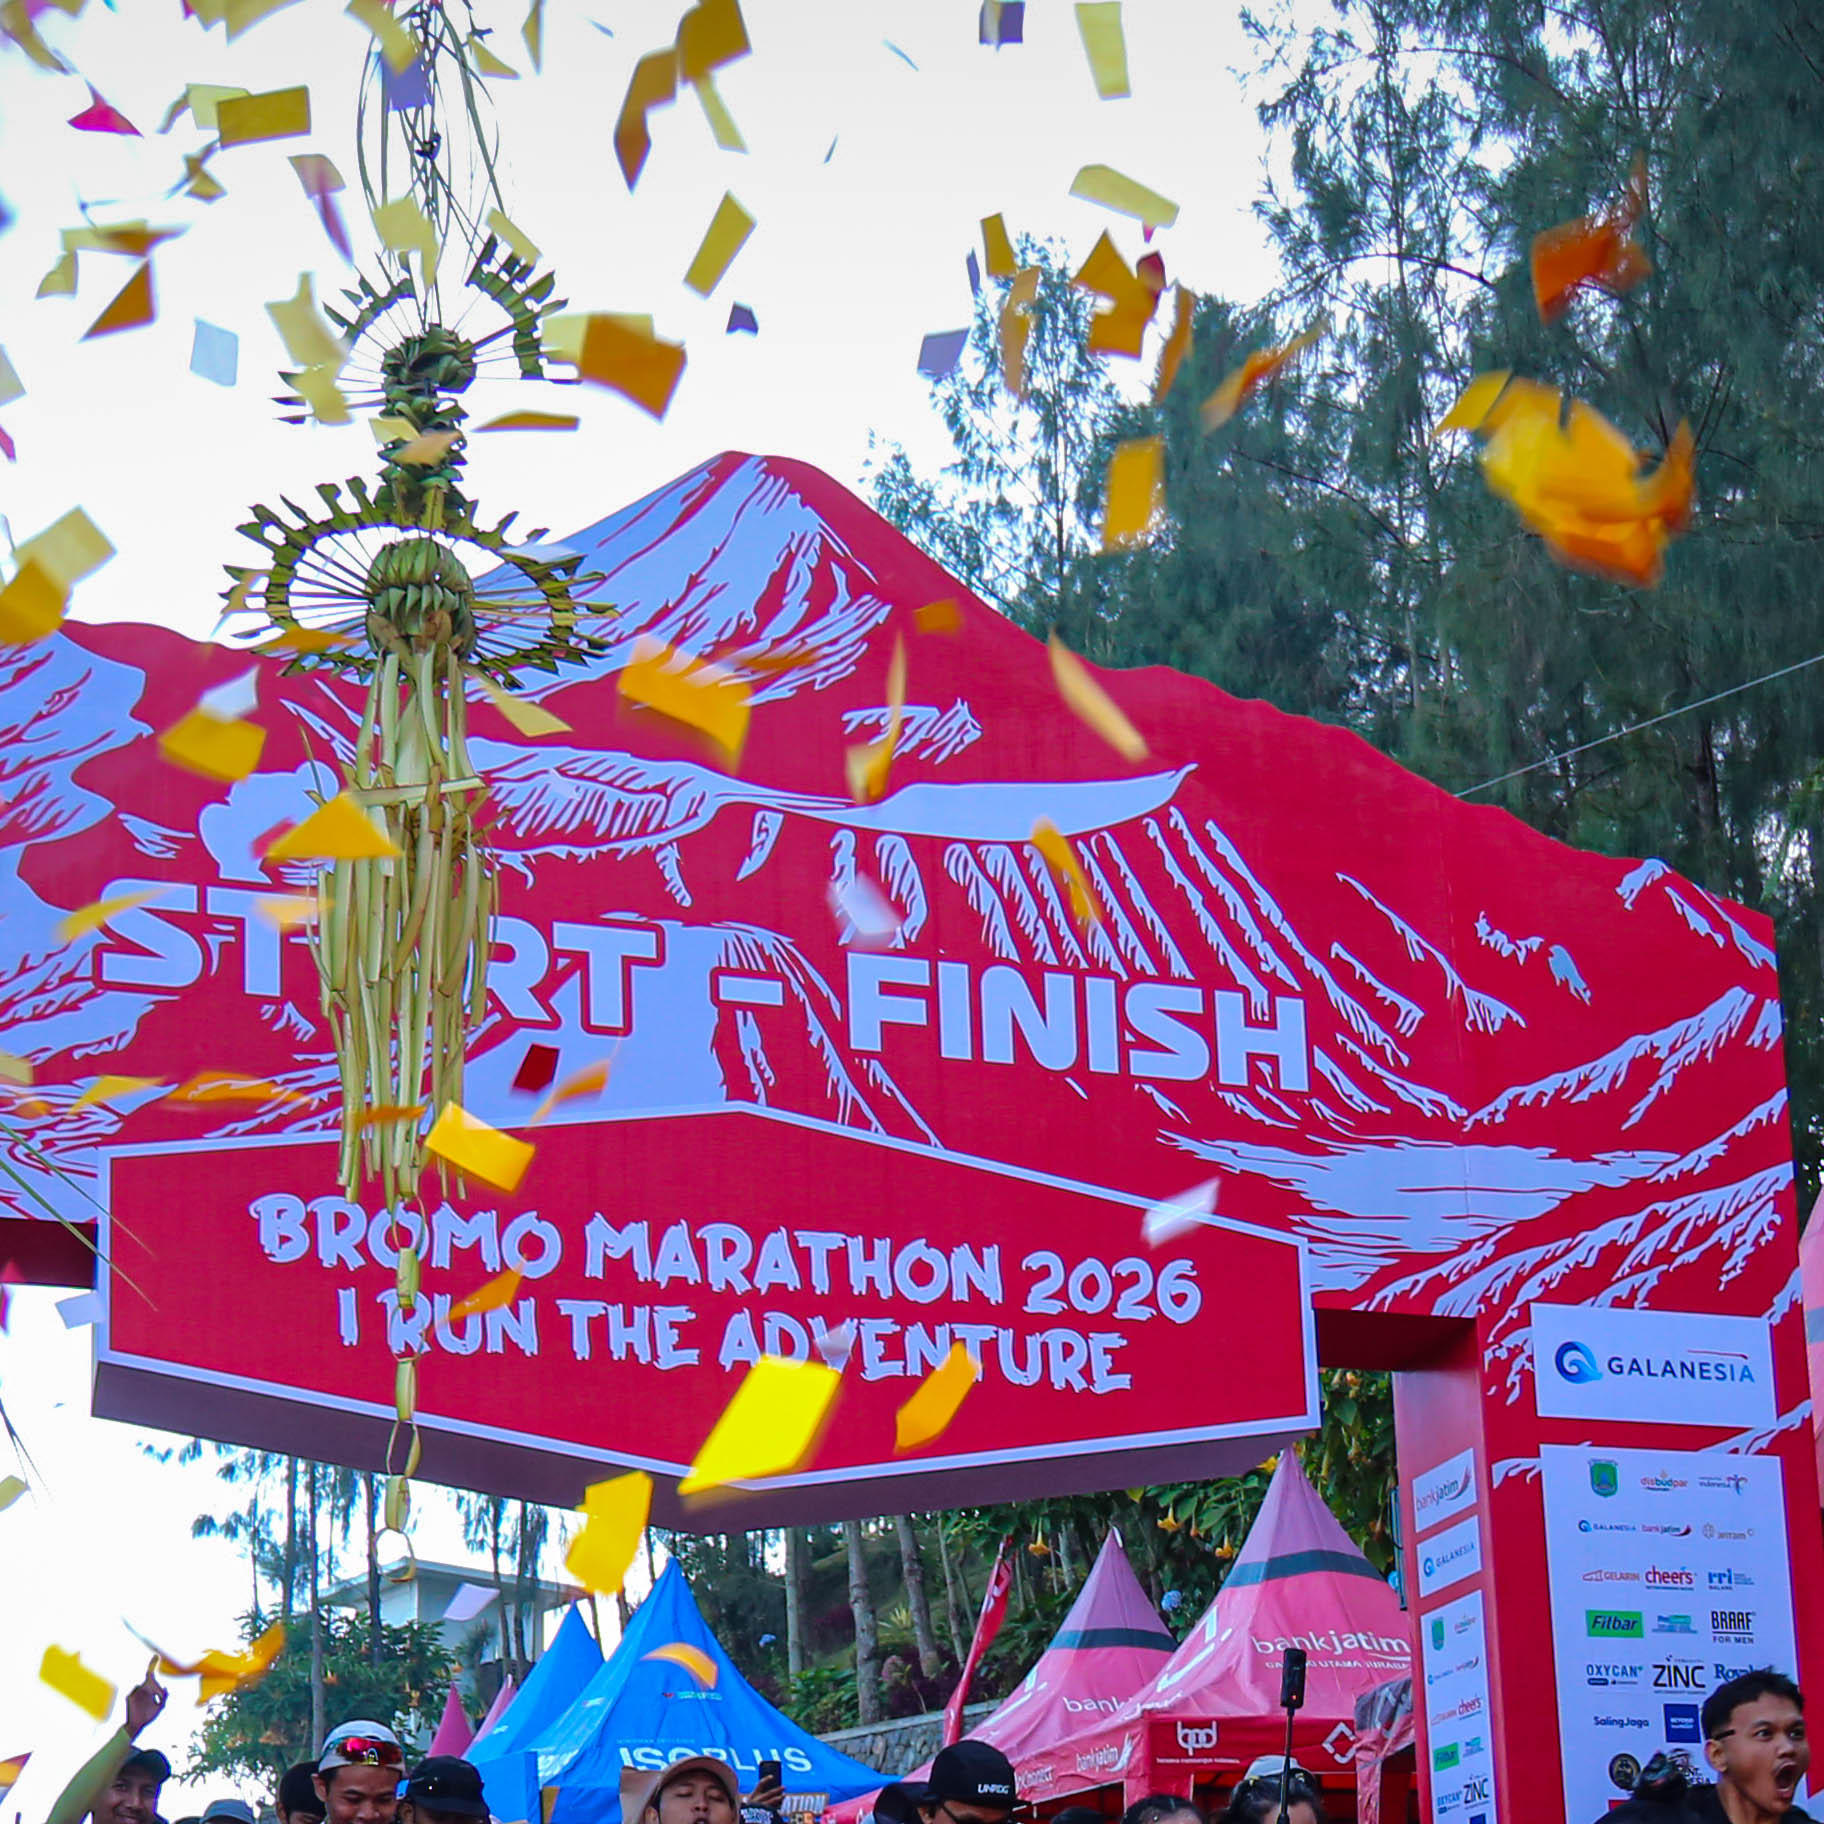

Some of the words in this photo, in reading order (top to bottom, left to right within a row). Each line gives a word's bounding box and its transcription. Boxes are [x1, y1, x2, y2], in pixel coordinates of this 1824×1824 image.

[98, 878, 659, 1031] STRT
[846, 951, 1310, 1092] FINISH
[248, 1193, 563, 1279] BROMO
[584, 1212, 1004, 1304] MARATHON
[1021, 1250, 1203, 1325] 2026
[338, 1286, 359, 1347] I
[376, 1287, 540, 1357] RUN
[556, 1298, 700, 1371] THE
[718, 1306, 1133, 1395] ADVENTURE
[1608, 1356, 1756, 1383] GALANESIA
[1644, 1564, 1694, 1585] cheers
[1708, 1568, 1733, 1585] rri
[1591, 1614, 1638, 1631] Fitbar
[1710, 1610, 1752, 1631] BRAAF
[1251, 1629, 1412, 1656] bankjatim
[1734, 1636, 1755, 1645] MEN
[1586, 1664, 1639, 1678] OXYCAN
[1652, 1664, 1707, 1689] ZINC
[1593, 1716, 1650, 1729] SalingJaga
[1463, 1777, 1490, 1805] ZINC
